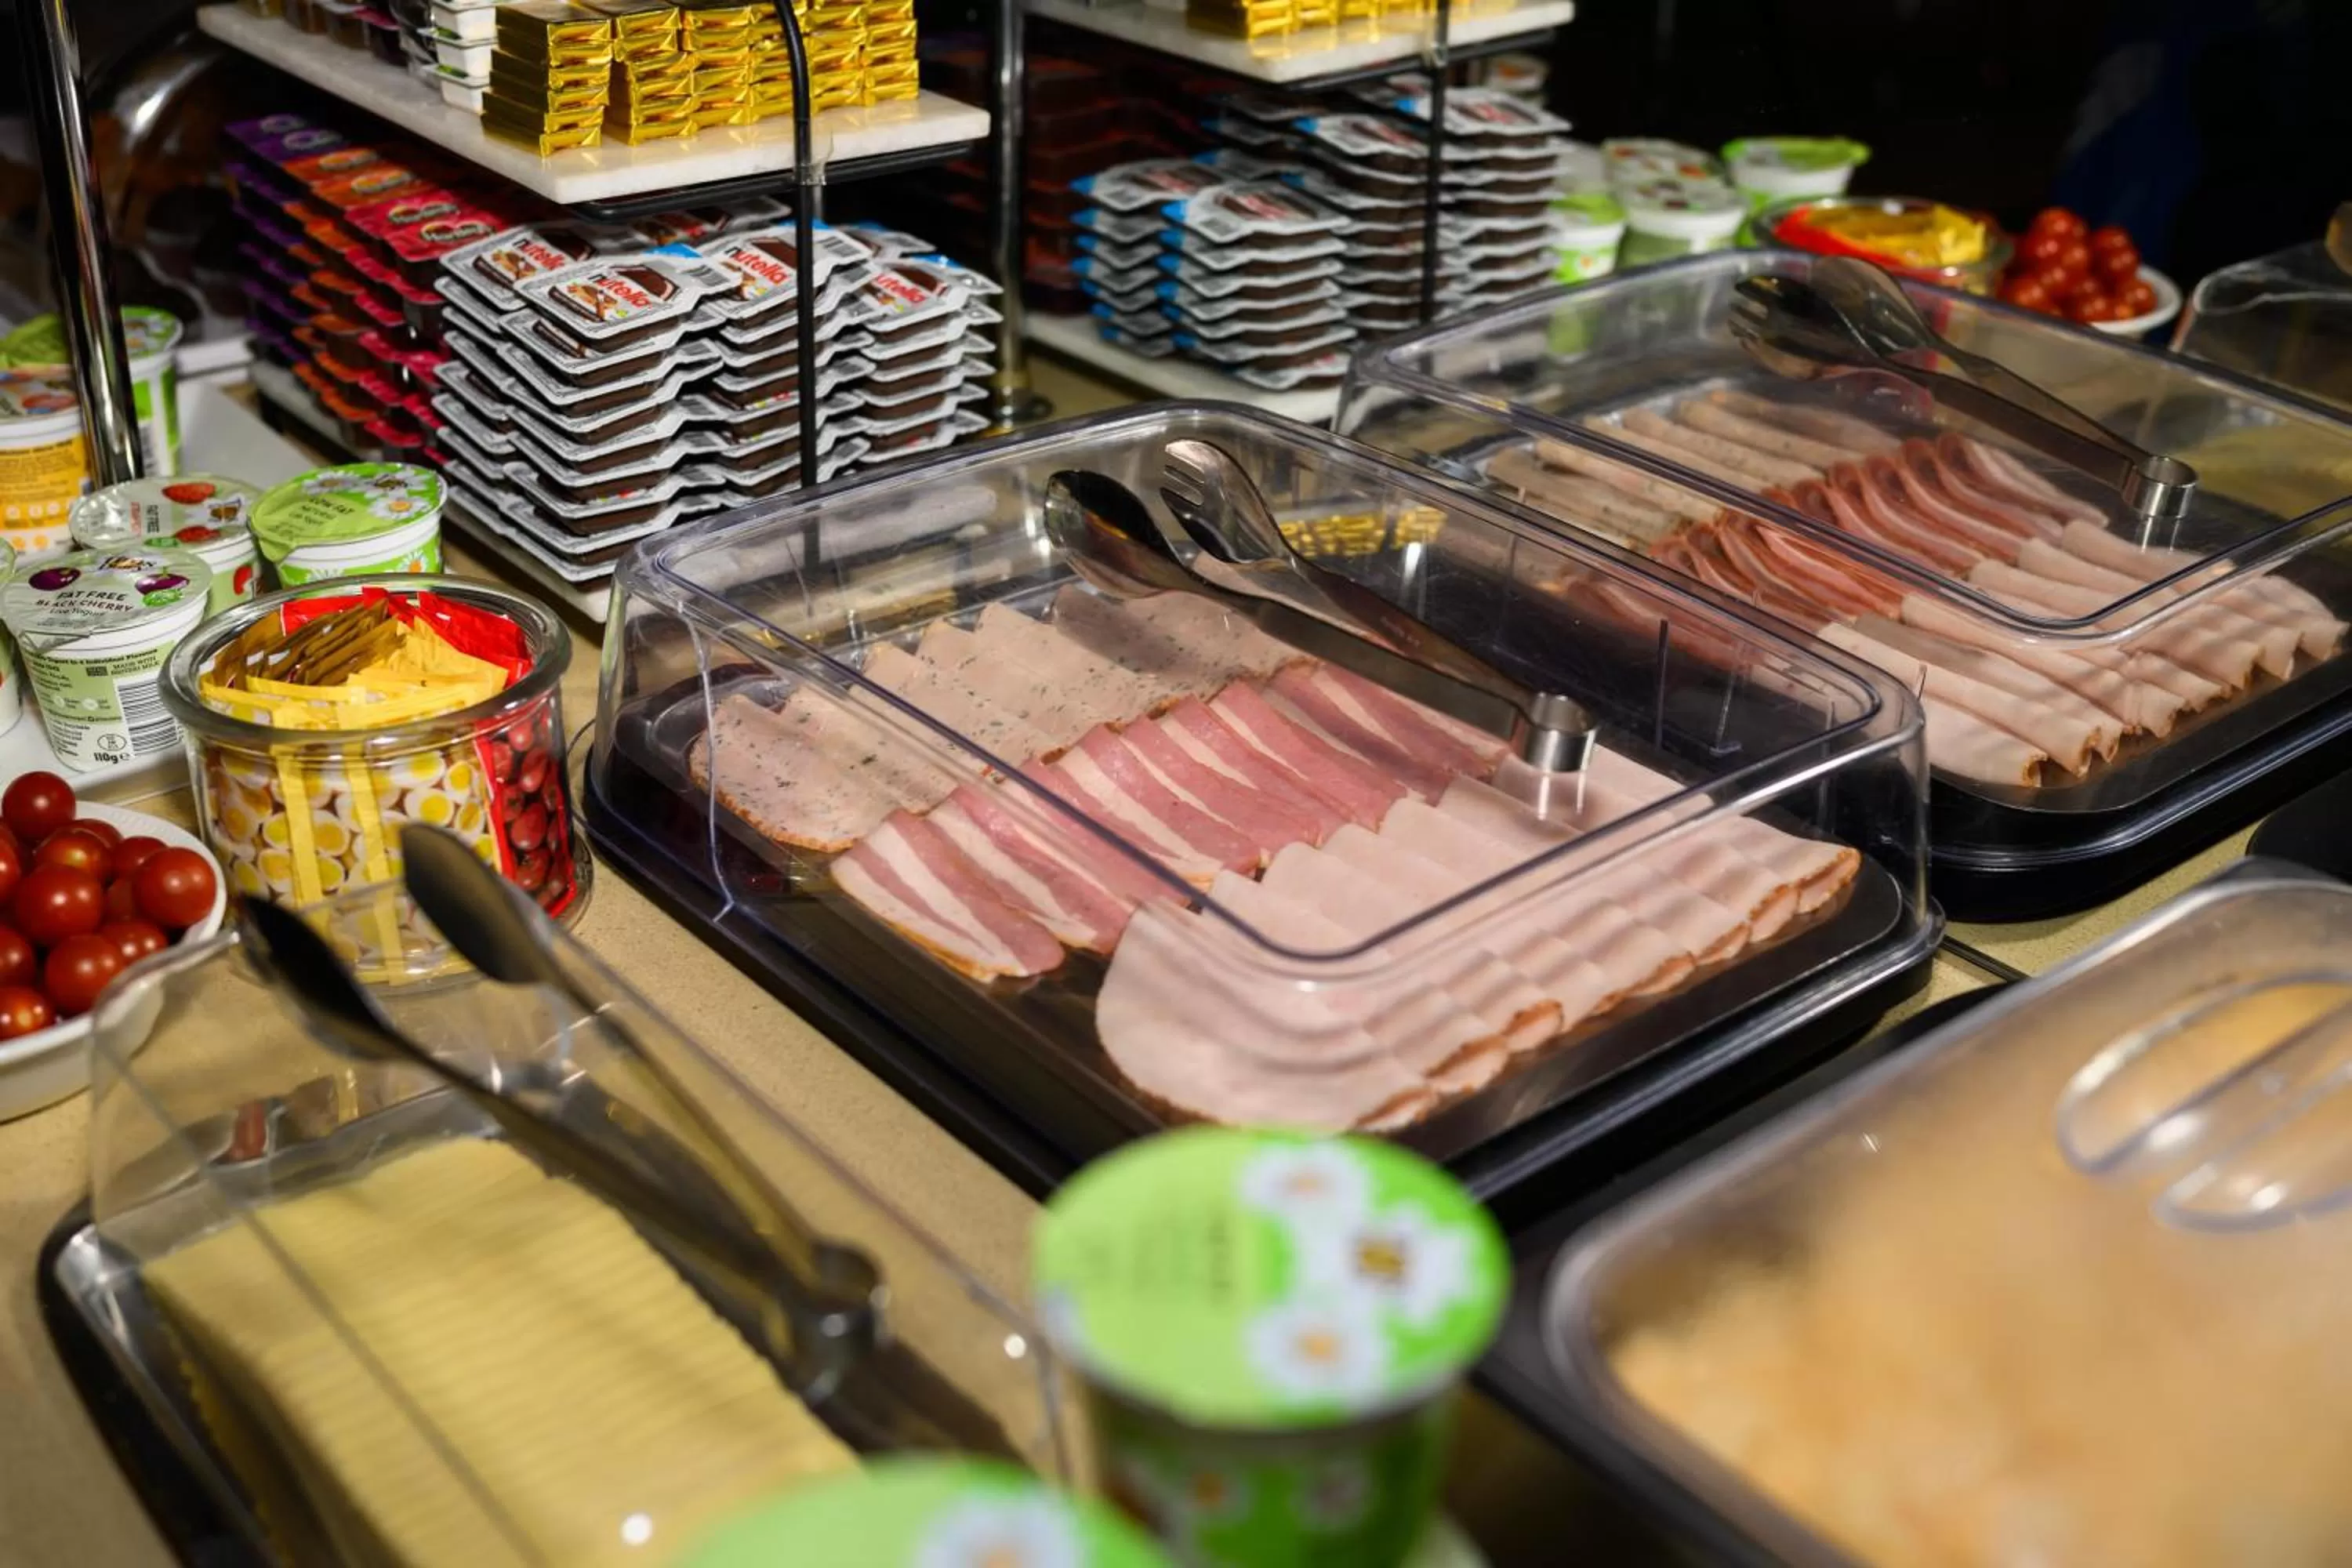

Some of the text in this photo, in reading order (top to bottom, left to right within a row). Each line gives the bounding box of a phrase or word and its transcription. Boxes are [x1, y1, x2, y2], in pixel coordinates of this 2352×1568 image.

[709, 246, 789, 286] nutella
[589, 274, 653, 310] nutella
[874, 274, 927, 303] utella
[36, 599, 134, 612] BLACK CHERRY
[56, 590, 128, 601] FAT FREE
[94, 752, 118, 764] 110g
